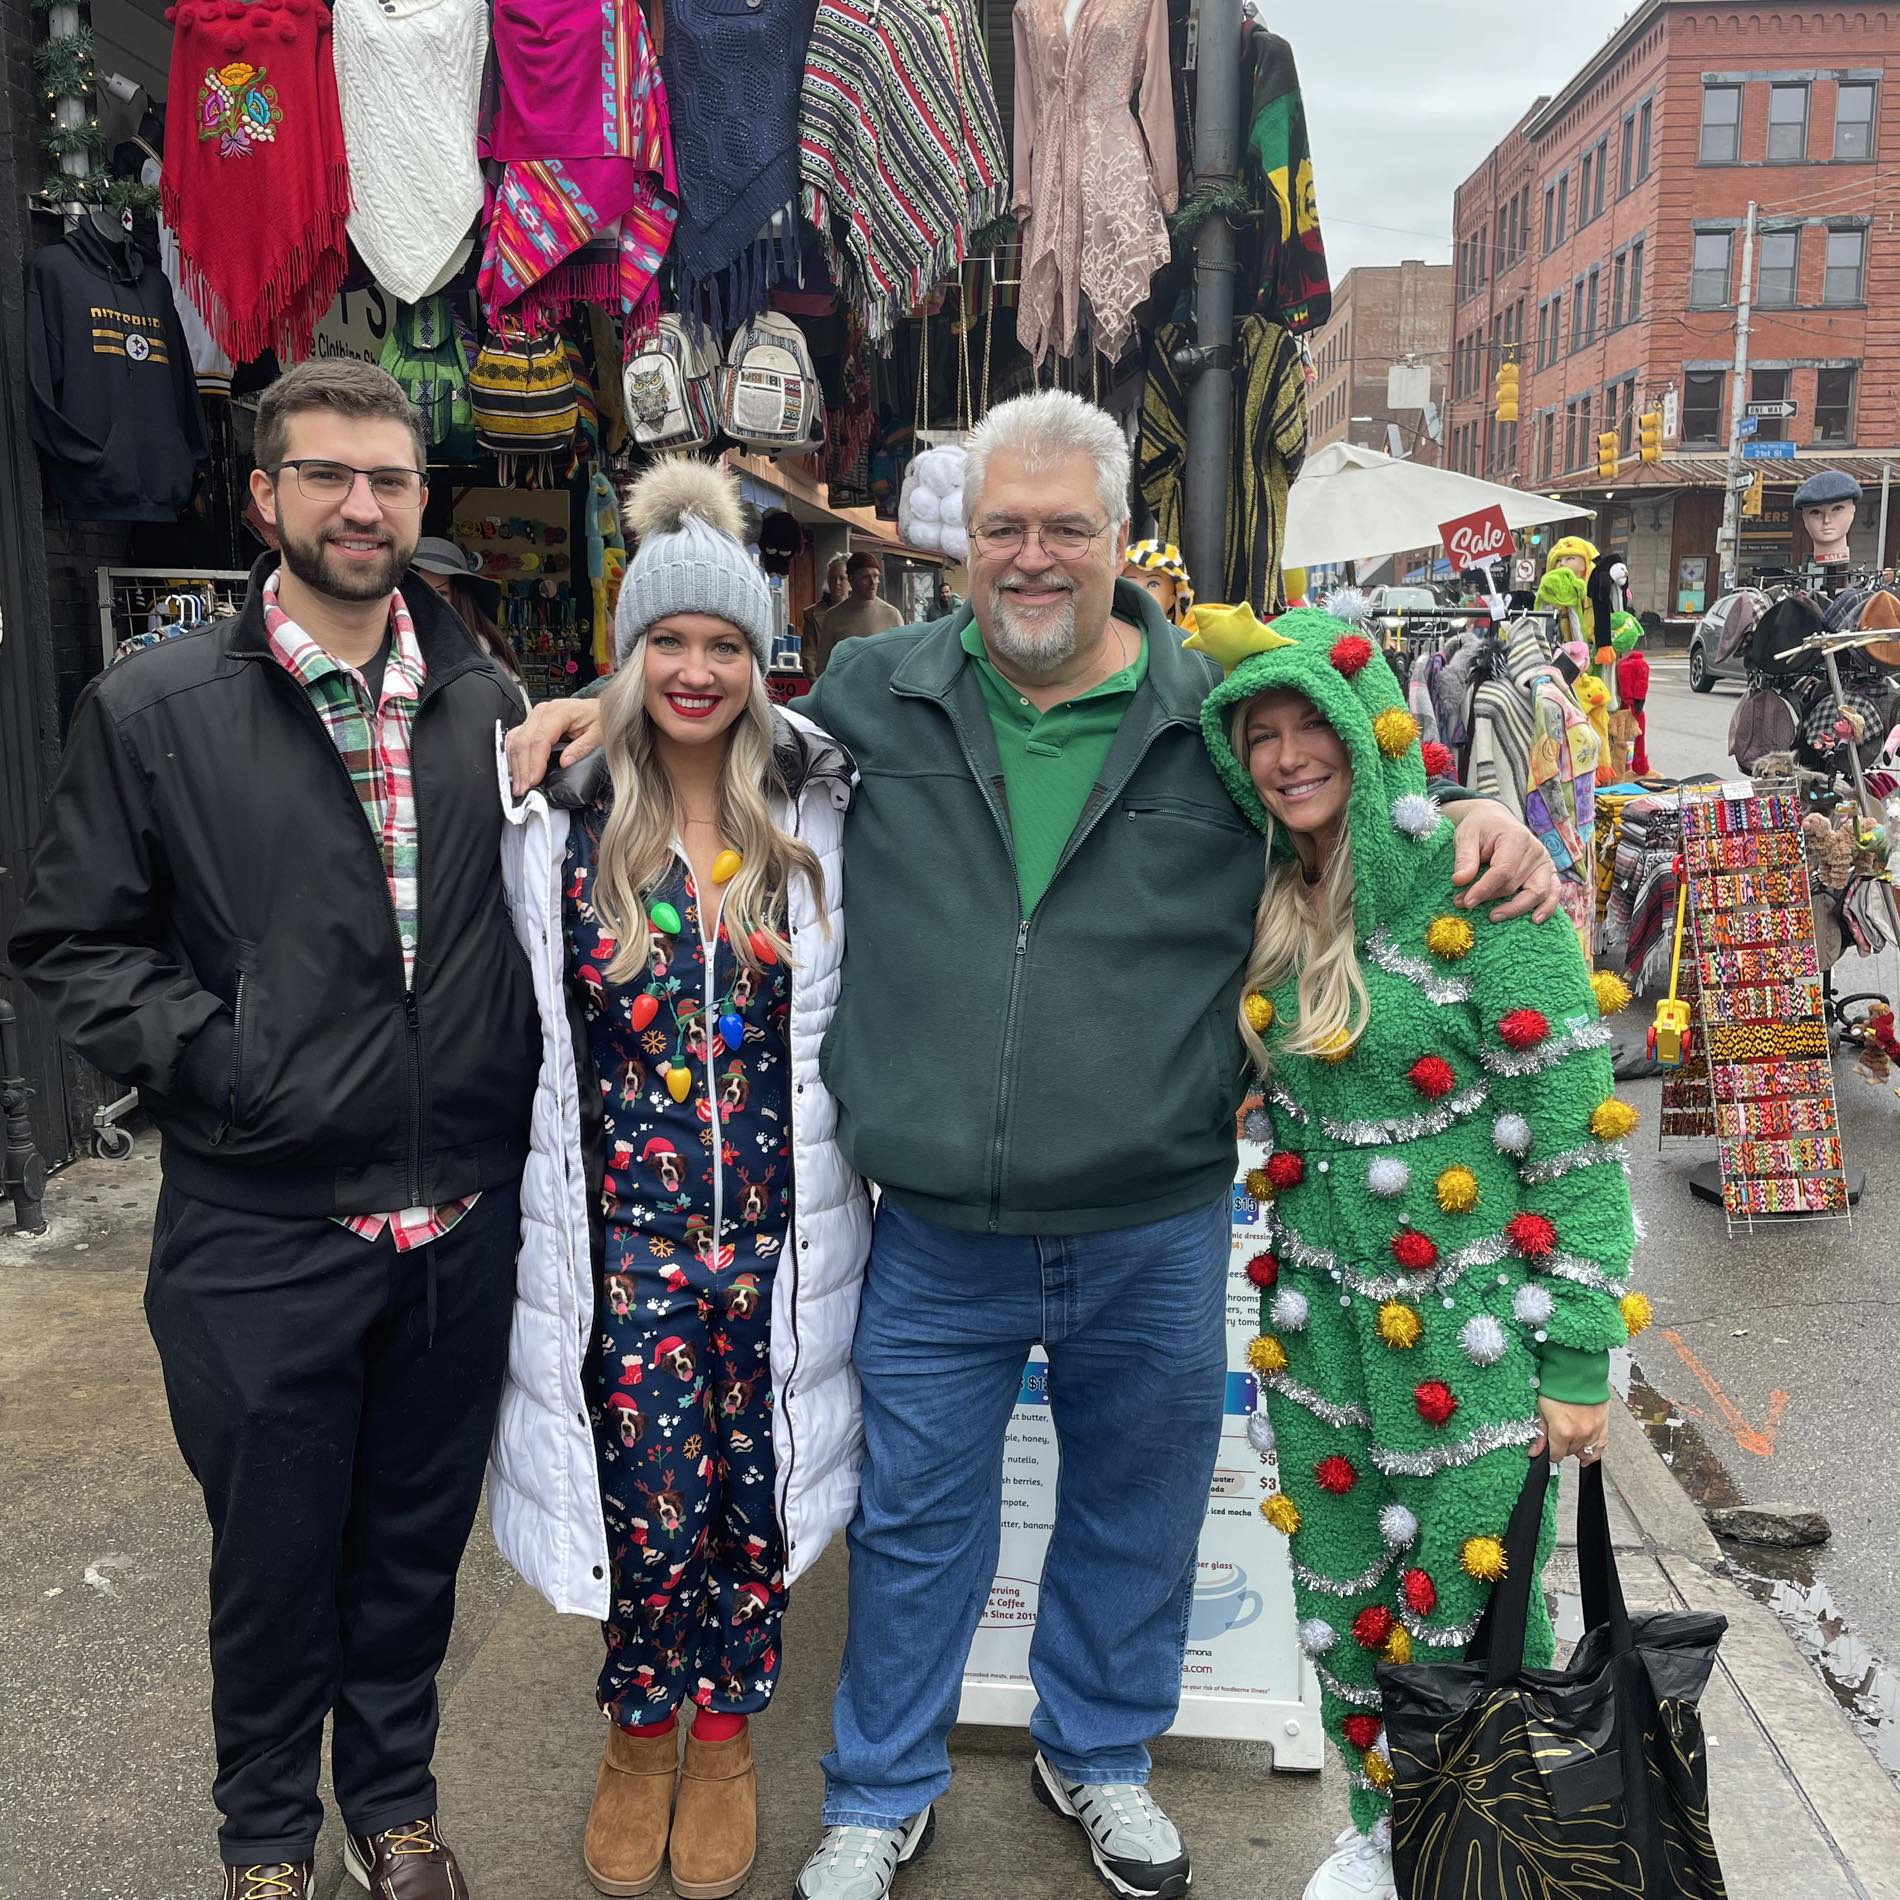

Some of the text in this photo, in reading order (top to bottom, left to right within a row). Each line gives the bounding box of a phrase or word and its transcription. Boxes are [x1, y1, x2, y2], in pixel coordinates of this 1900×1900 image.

[1767, 405, 1783, 413] WAY
[1451, 521, 1505, 569] Sale
[1234, 1196, 1257, 1212] $15
[1228, 1293, 1259, 1302] hrooms
[1227, 1306, 1242, 1314] ers,
[1226, 1319, 1260, 1327] ry toma
[1022, 1413, 1049, 1423] butter,
[1005, 1434, 1050, 1445] ple, honey,
[1007, 1456, 1039, 1465] nutella,
[1260, 1451, 1277, 1466] $5
[1001, 1477, 1043, 1487] sh berries,
[1260, 1476, 1277, 1490] $3
[1001, 1499, 1029, 1508] mpote,
[1211, 1507, 1252, 1517] iced mocha
[1211, 1561, 1233, 1571] glass
[991, 1586, 1020, 1597] erving
[997, 1598, 1025, 1609] Coffee
[991, 1610, 1014, 1619] Since
[1016, 1612, 1037, 1620] 2011
[1185, 1648, 1213, 1656] emona
[1183, 1664, 1213, 1674] a.com
